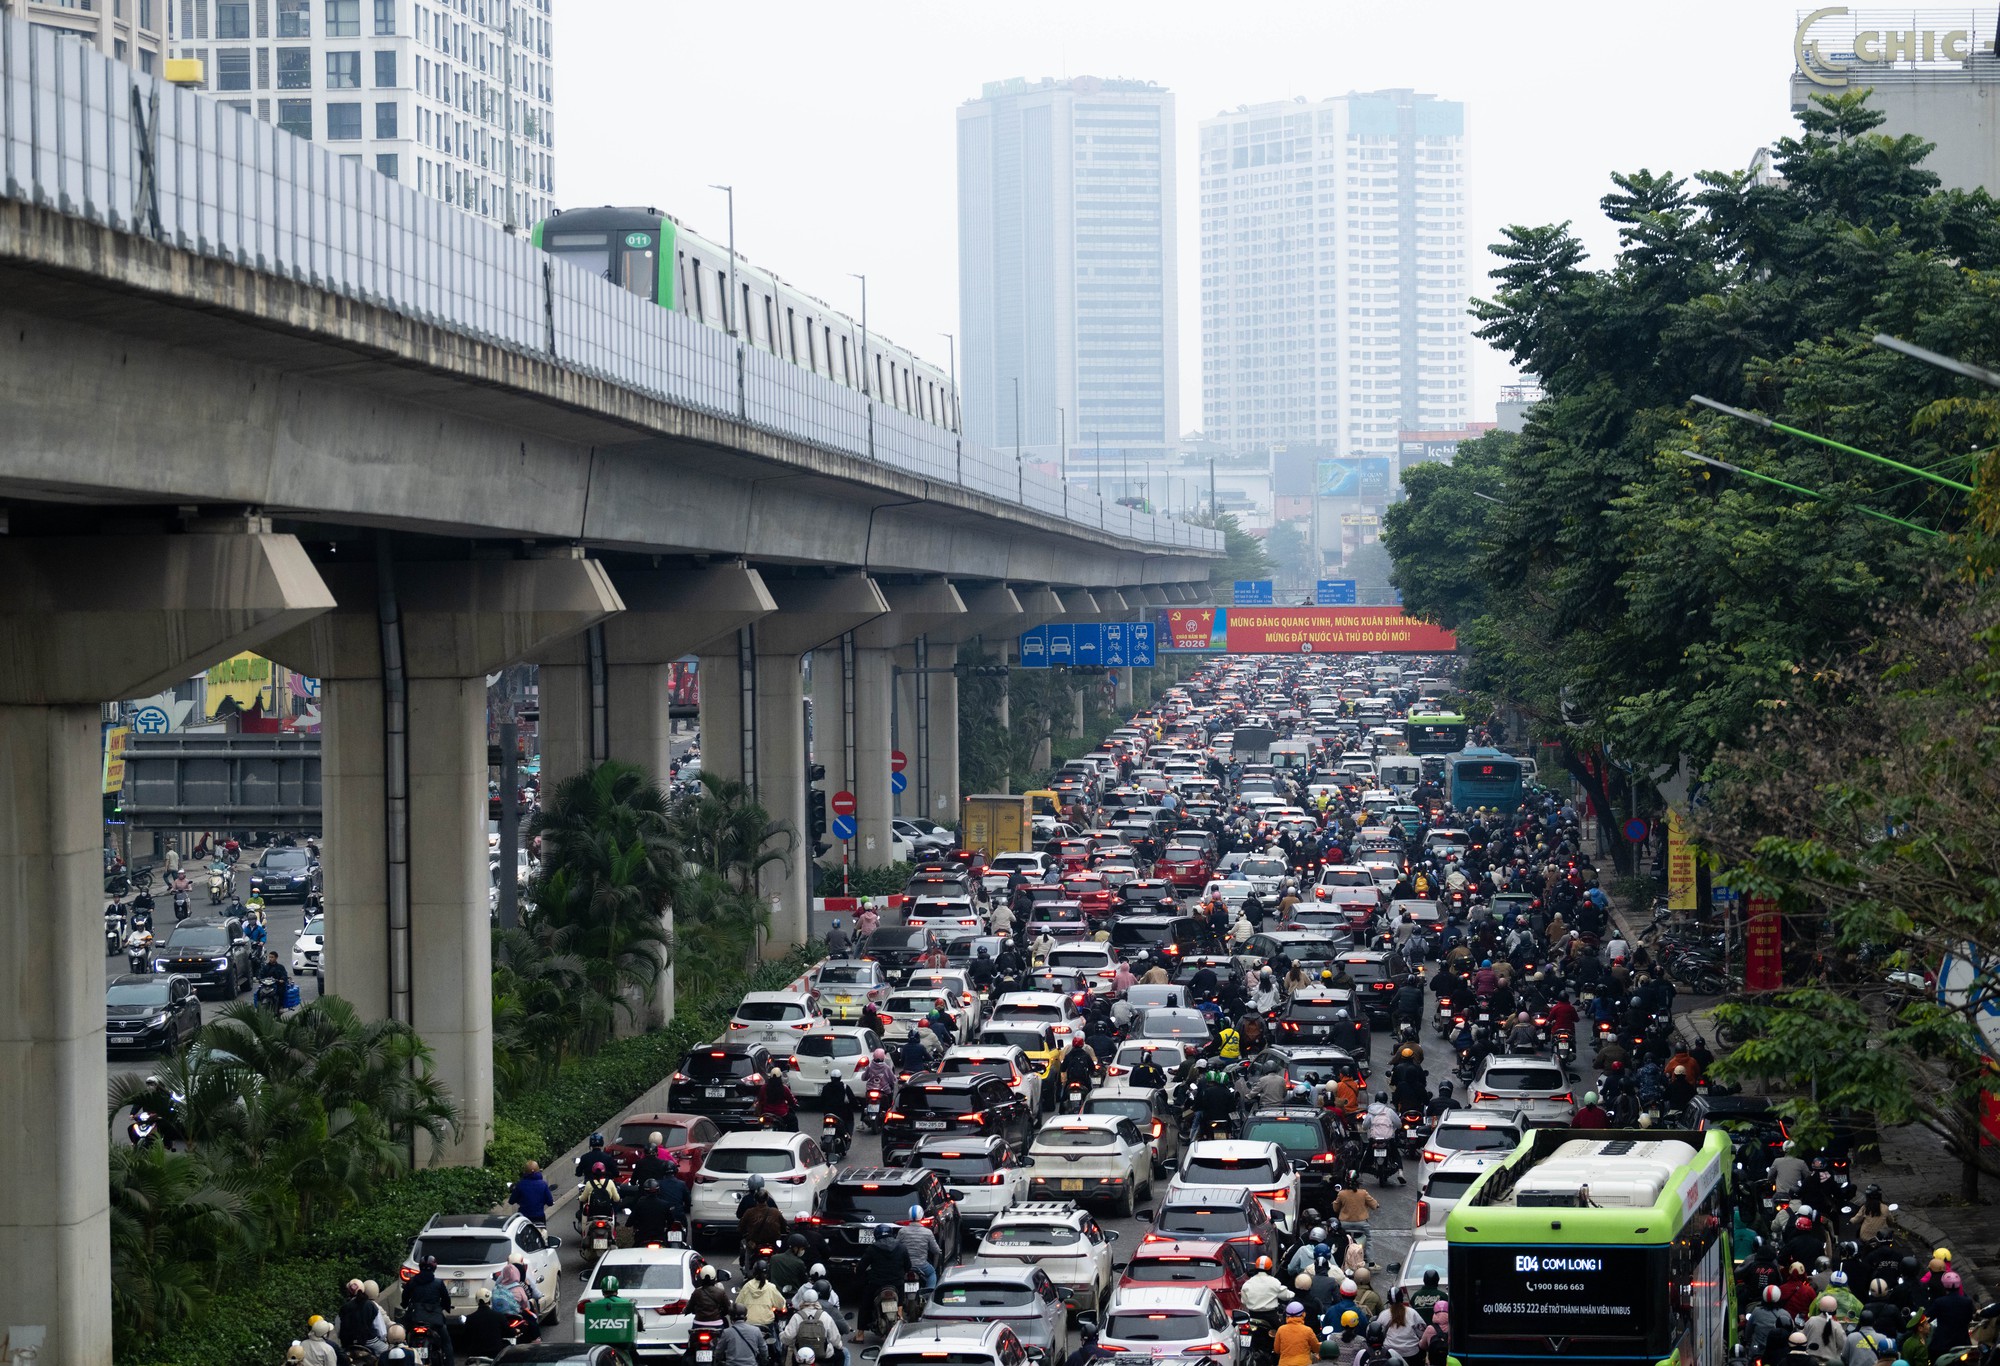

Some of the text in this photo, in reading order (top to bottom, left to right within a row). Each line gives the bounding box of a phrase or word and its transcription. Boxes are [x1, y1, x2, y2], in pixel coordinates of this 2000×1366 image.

[1853, 30, 1968, 62] CHIC
[628, 236, 647, 245] 011
[1230, 615, 1255, 627] MỪNG
[1256, 614, 1280, 627] ĐẢNG
[1281, 617, 1310, 628] QUANG
[1311, 617, 1334, 628] VINH,
[1335, 615, 1360, 627] MỪNG
[1361, 615, 1384, 626] XUÂN
[1385, 615, 1404, 626] BÍNH
[1265, 629, 1411, 642] MỪNG ĐẤT NƯỚC VÀ THỦ ĐÔ ĐỔI MỚI!
[1179, 639, 1206, 648] 2026
[1482, 765, 1493, 774] 27
[1515, 1255, 1539, 1272] E04
[1568, 1258, 1596, 1270] LONG
[1533, 1283, 1585, 1291] 1900 866 663
[1483, 1304, 1494, 1315] GỌI
[1494, 1302, 1511, 1314] 0866
[1512, 1302, 1525, 1314] 355
[1526, 1302, 1540, 1314] 222
[1560, 1303, 1580, 1314] THÀNH
[1580, 1304, 1597, 1314] NHÂN
[1597, 1304, 1610, 1314] VIÊN
[1610, 1305, 1631, 1315] VINBUS
[588, 1318, 630, 1330] XFAST
